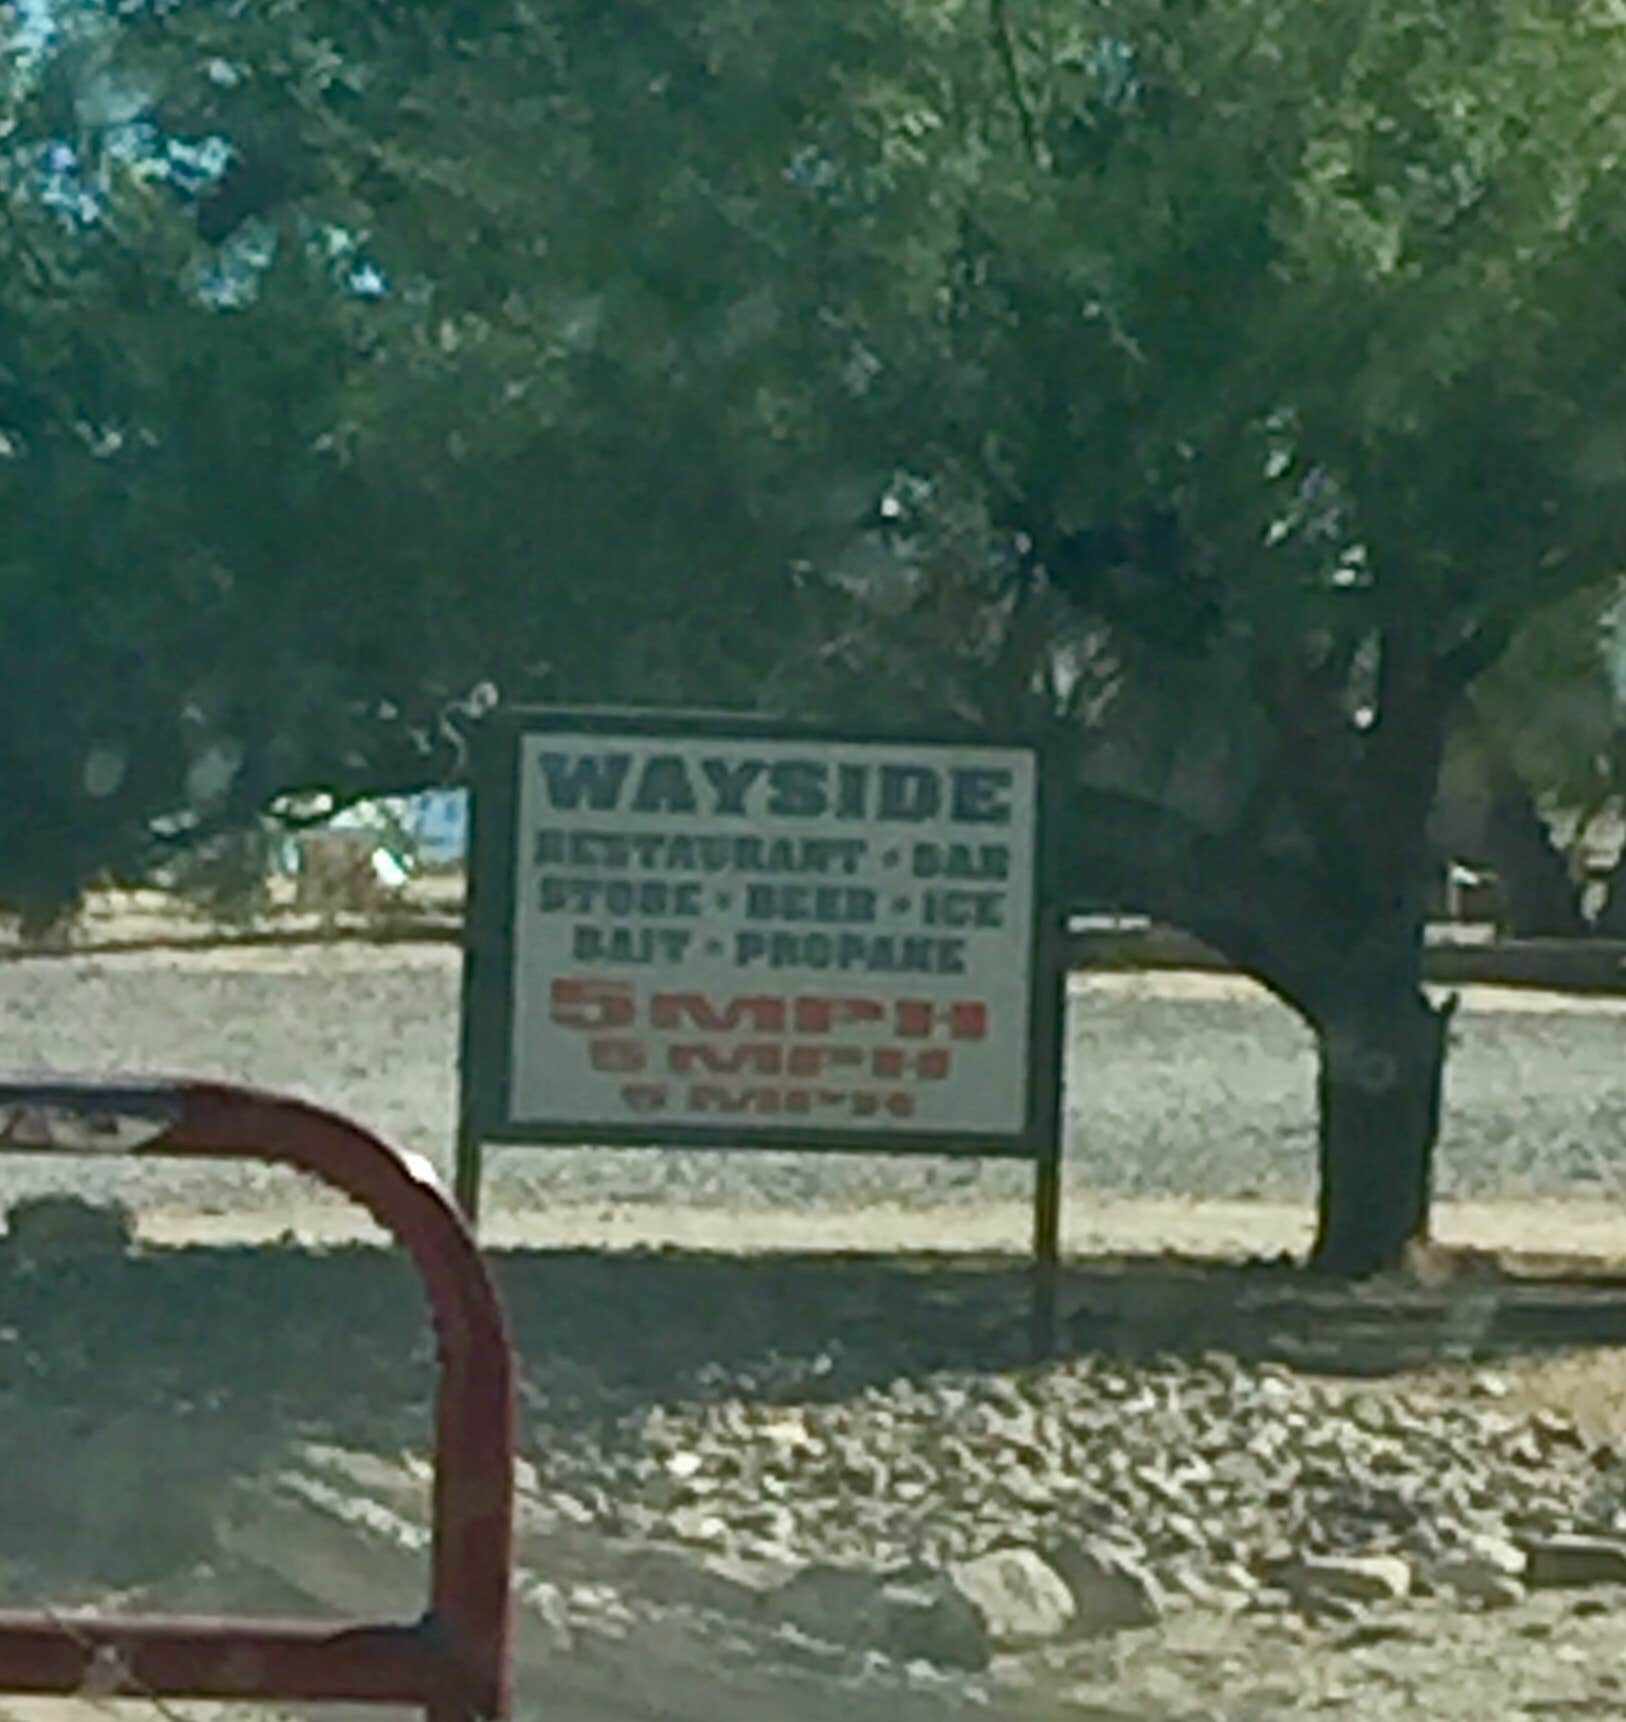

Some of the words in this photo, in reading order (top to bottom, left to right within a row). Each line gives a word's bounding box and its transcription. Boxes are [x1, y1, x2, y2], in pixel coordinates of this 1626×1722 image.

[538, 752, 1013, 824] WAYSIDE
[534, 831, 866, 874] RESTAURANT
[913, 844, 1009, 880] BAR
[539, 878, 701, 916] STORE
[746, 884, 876, 920] BEER
[922, 891, 1005, 928] ICE
[574, 925, 690, 964] BAIT
[736, 931, 966, 973] PROPANE
[551, 978, 634, 1030] 5
[651, 992, 987, 1040] MPH
[591, 1039, 646, 1072] 5
[667, 1043, 952, 1080] MPH
[687, 1086, 915, 1118] MPH
